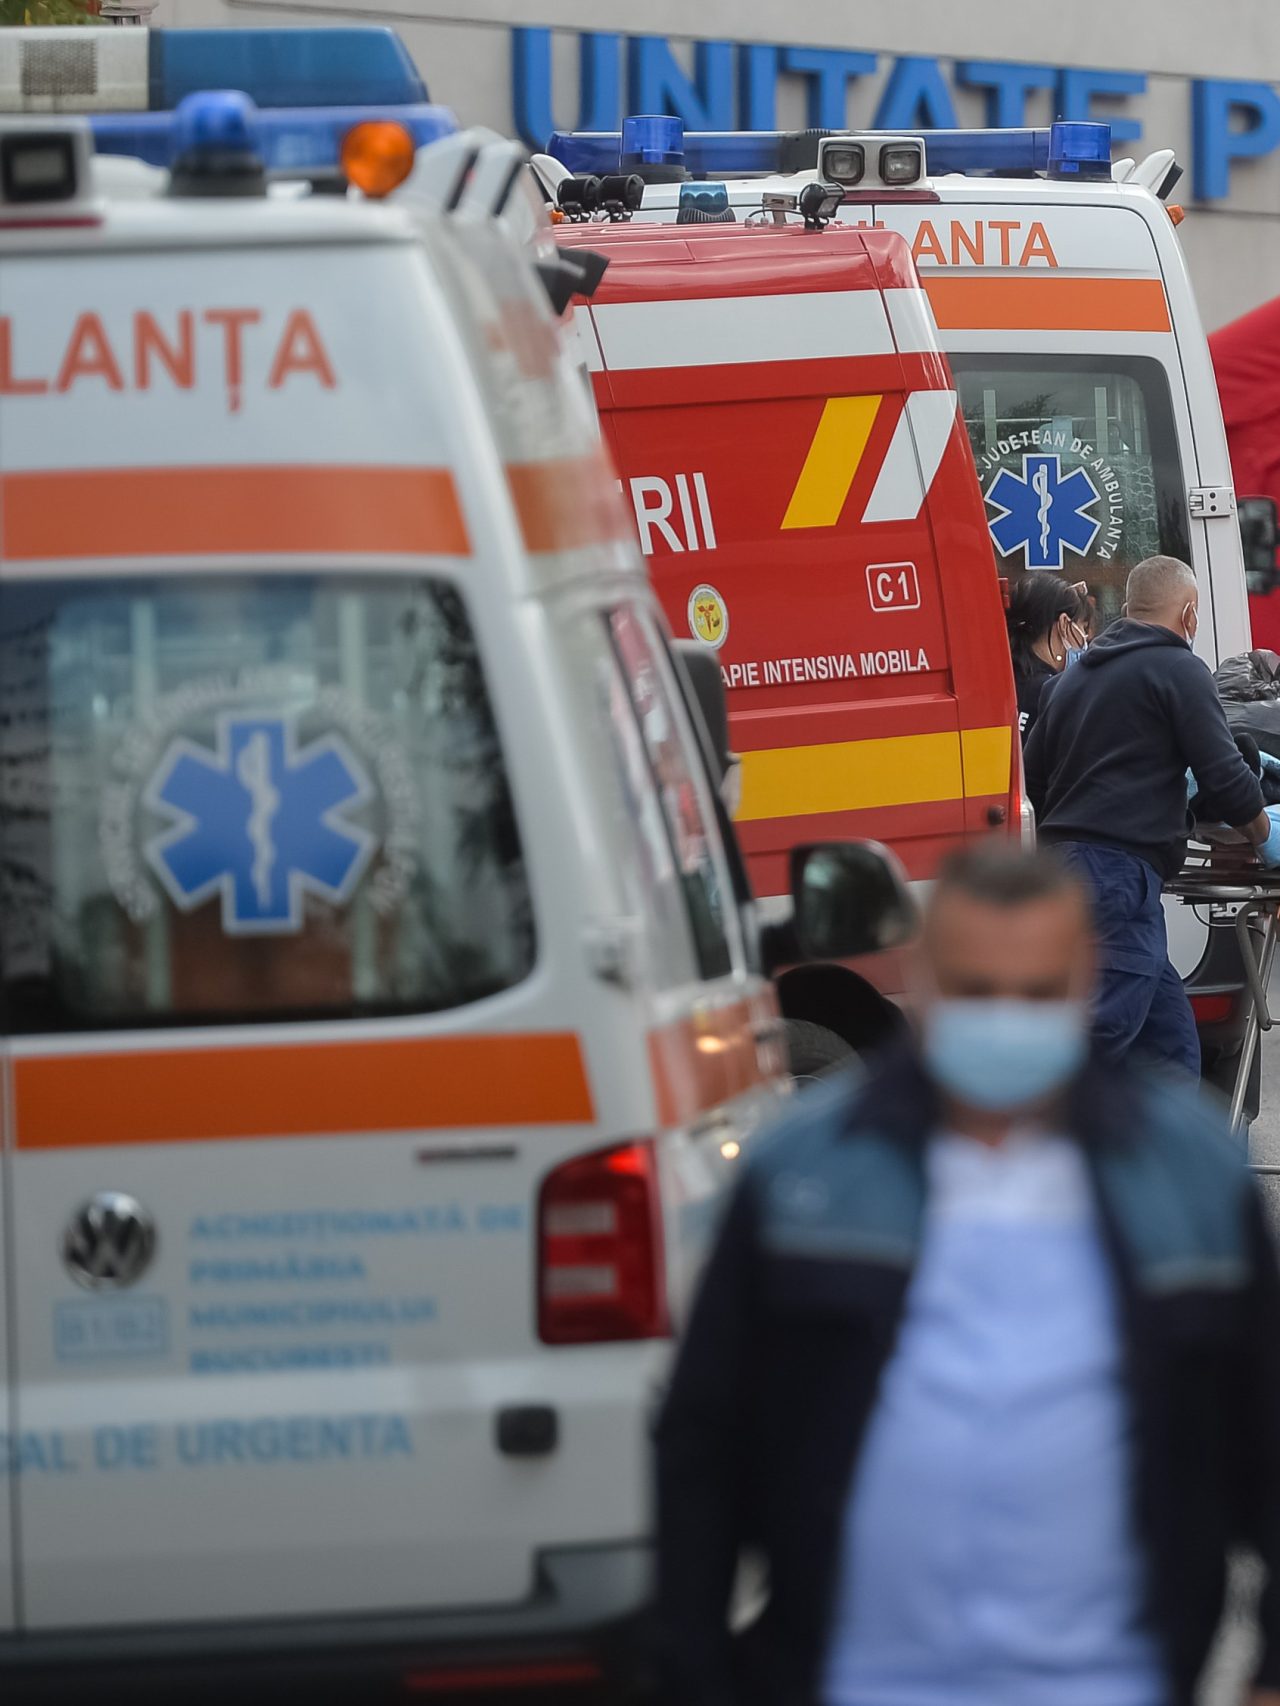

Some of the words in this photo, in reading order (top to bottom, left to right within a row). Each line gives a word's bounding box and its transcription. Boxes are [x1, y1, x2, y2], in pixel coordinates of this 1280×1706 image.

[839, 219, 1059, 268] ANTA
[1069, 437, 1094, 460] DE
[617, 472, 717, 555] RII
[763, 654, 857, 685] INTENSIVA
[860, 648, 930, 676] MOBILA
[94, 1423, 156, 1470] DE
